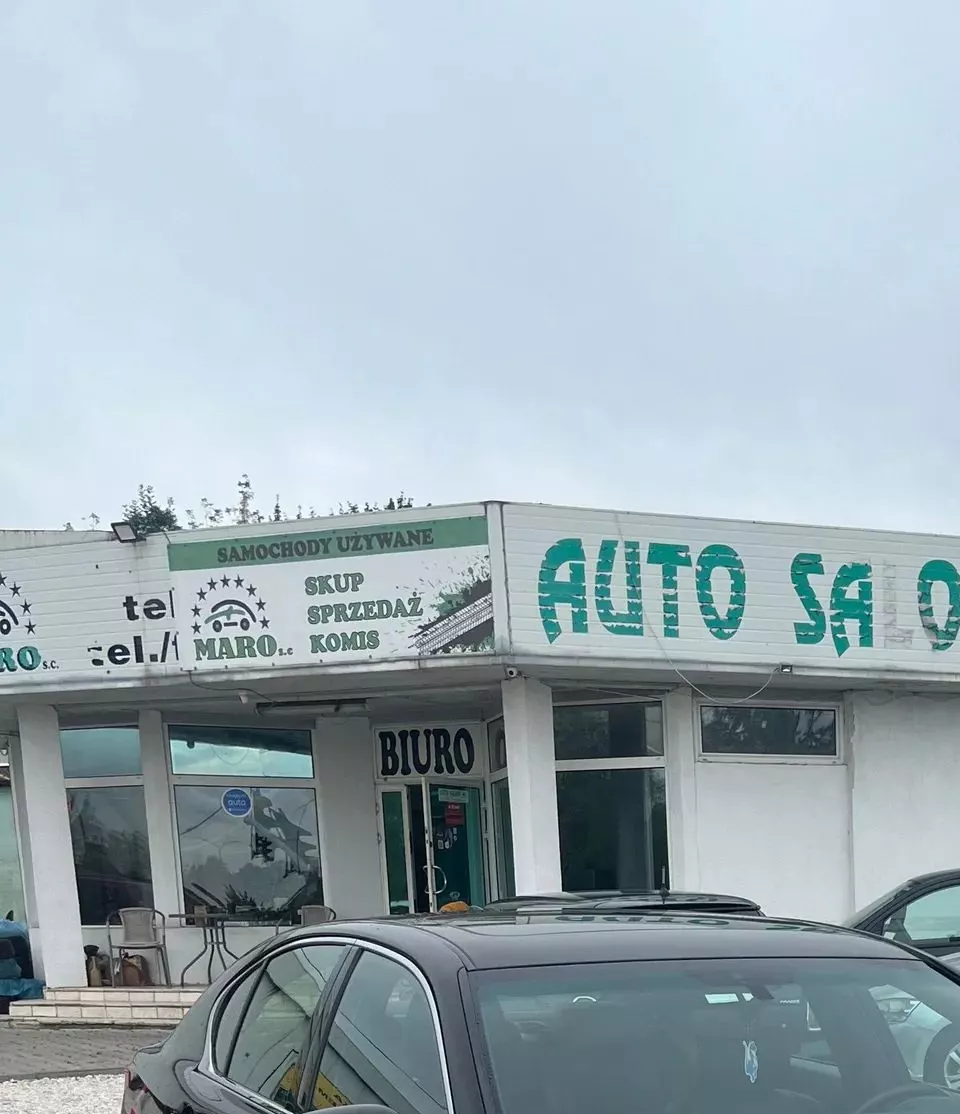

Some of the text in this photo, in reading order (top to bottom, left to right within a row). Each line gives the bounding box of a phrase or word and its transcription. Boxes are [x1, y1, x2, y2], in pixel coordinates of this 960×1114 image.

[217, 537, 332, 563] SAMOCHODY
[304, 572, 365, 595] SKUP
[537, 537, 747, 644] AUTO
[307, 591, 424, 625] SPRZEDAŻ
[193, 634, 278, 661] MARO
[309, 630, 381, 654] KOMIS
[378, 727, 475, 776] BIURO
